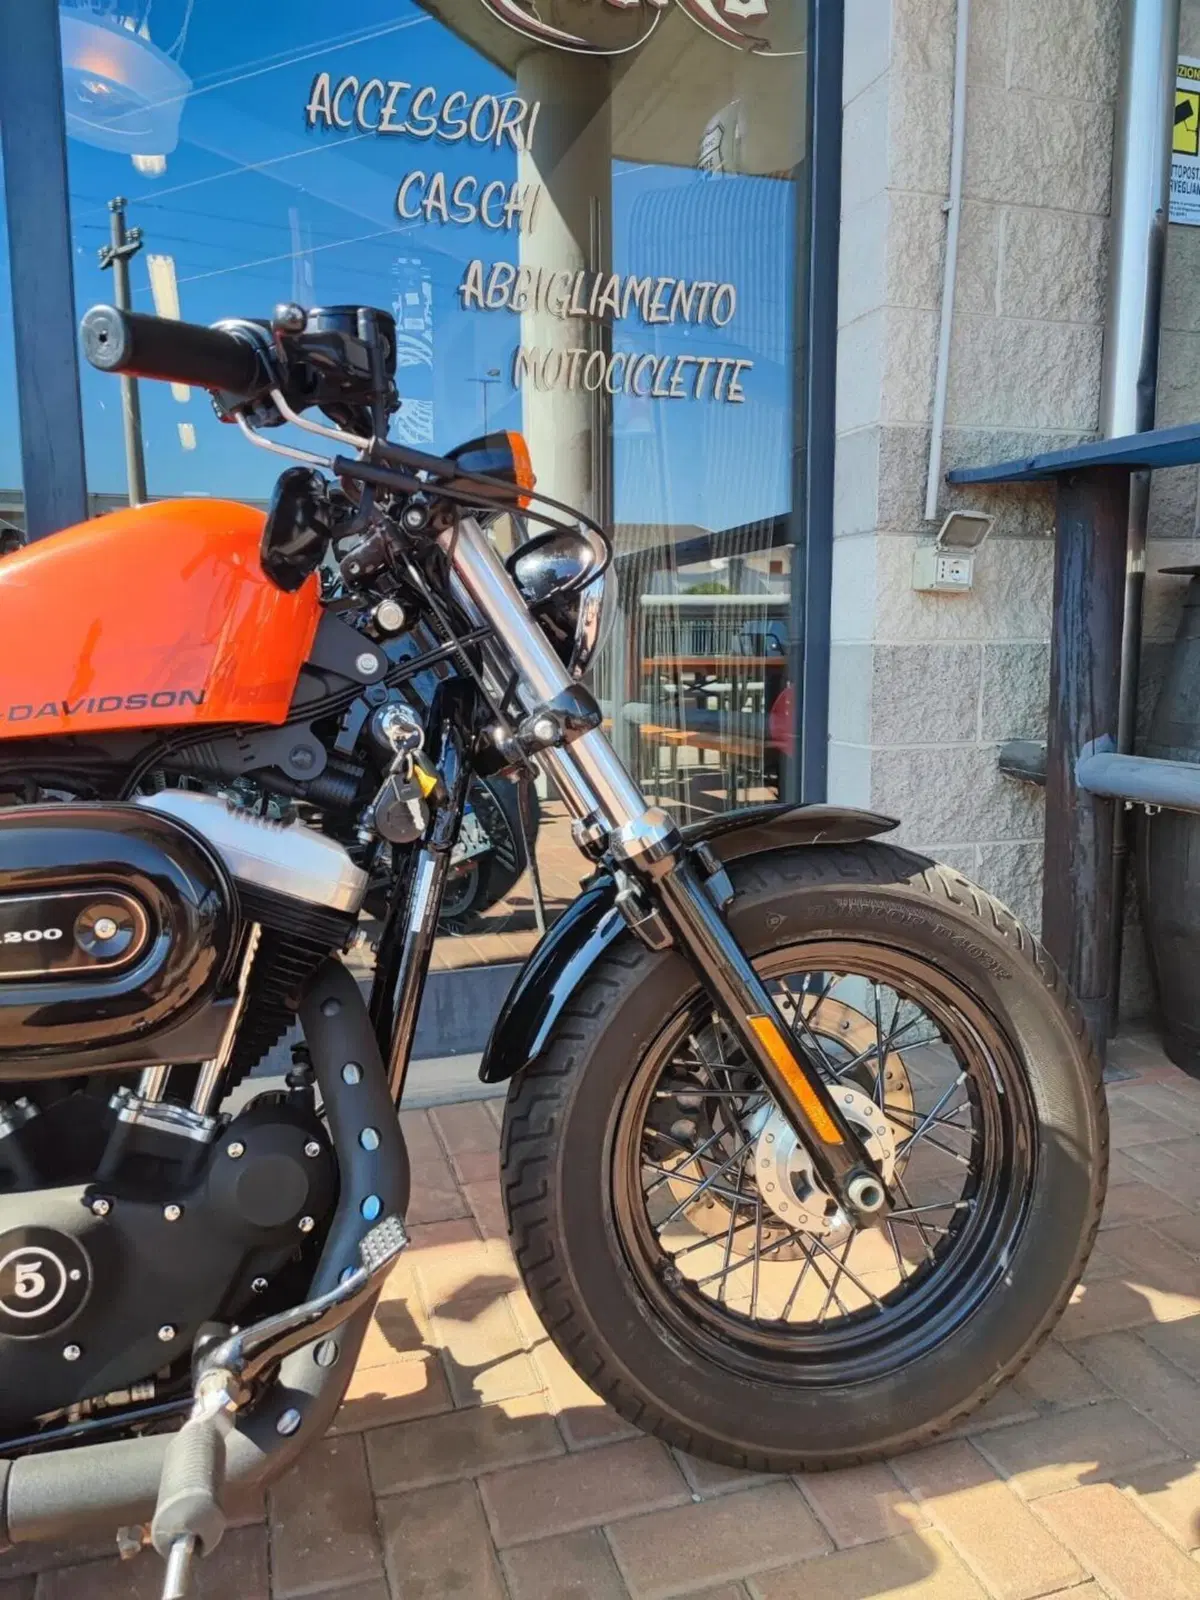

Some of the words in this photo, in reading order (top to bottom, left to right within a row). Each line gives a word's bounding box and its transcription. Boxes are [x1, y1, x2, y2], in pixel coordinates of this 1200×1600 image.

[305, 72, 541, 152] ACCESSORI
[396, 170, 541, 234] CASCHI
[459, 259, 737, 328] ABBIGLIAMENTO
[511, 345, 754, 402] MOTOCICLETTE
[14, 1261, 46, 1299] 5
